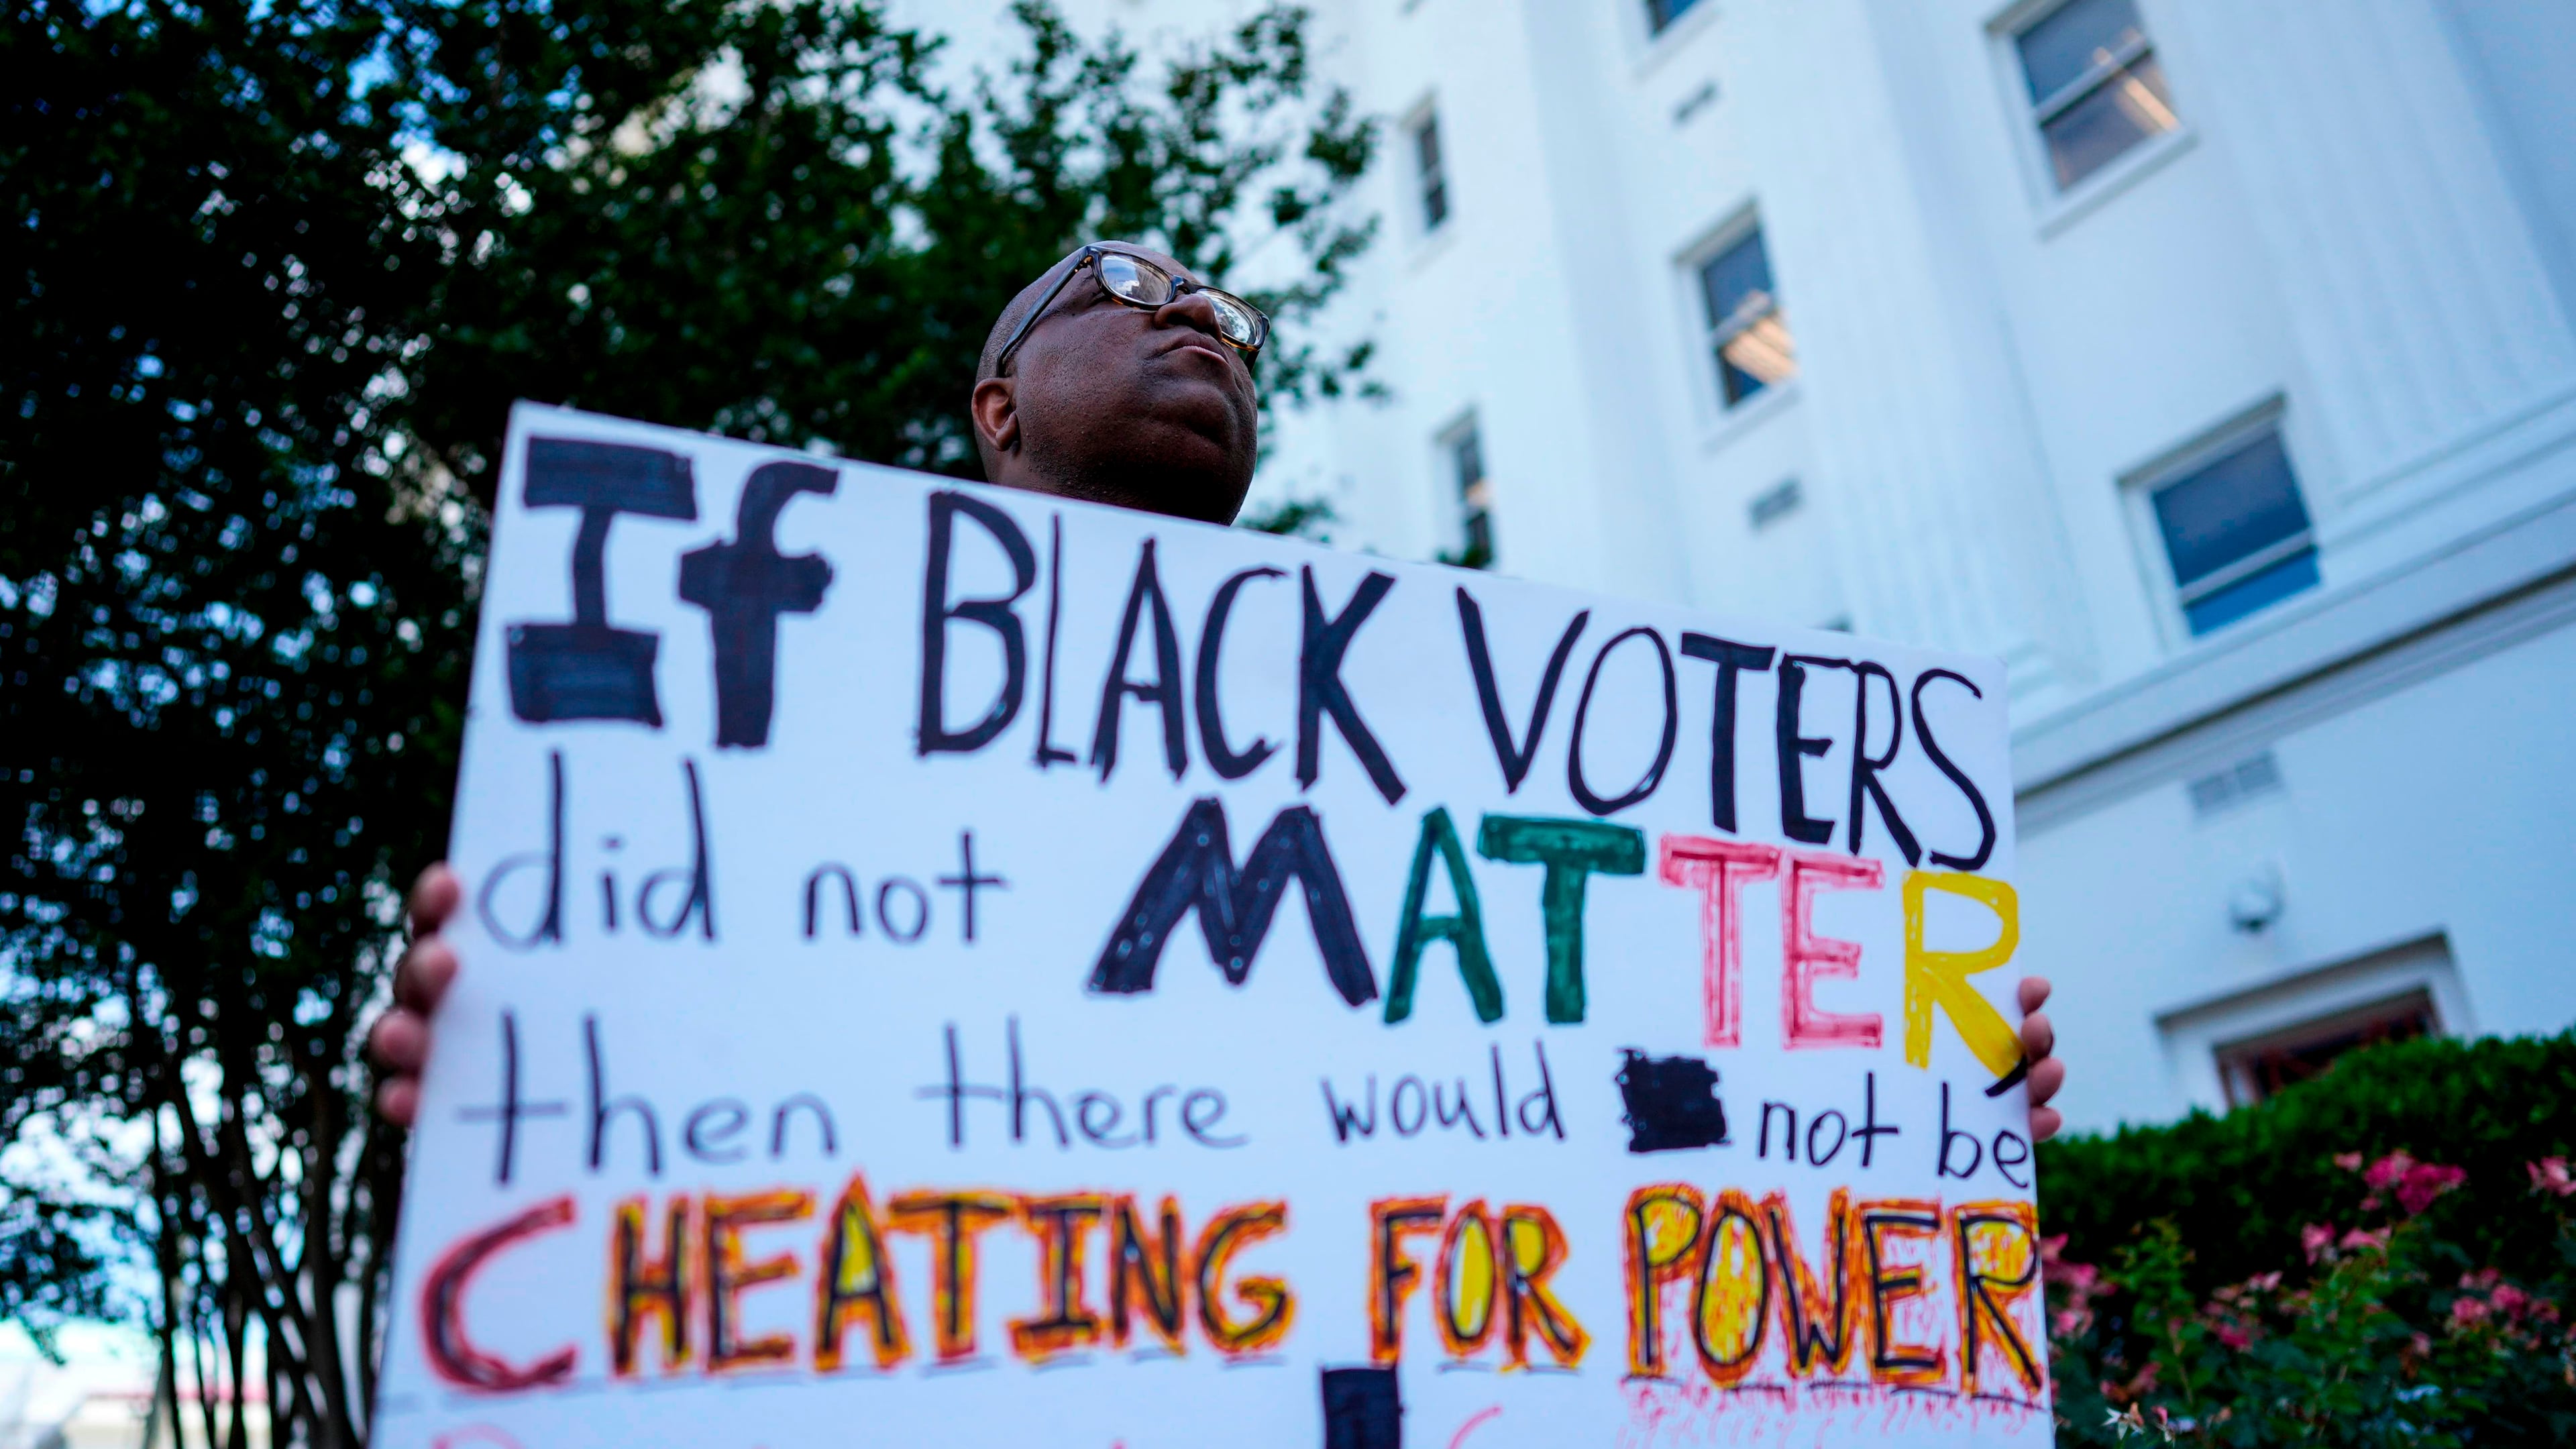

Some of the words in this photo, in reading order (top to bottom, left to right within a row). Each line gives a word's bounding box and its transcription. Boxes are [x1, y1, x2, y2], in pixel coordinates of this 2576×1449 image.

[508, 435, 839, 748] If
[917, 491, 1407, 805] BLACK
[1456, 586, 1996, 870] VOTERS
[478, 747, 718, 953] did
[805, 830, 1010, 945] not
[456, 1008, 838, 1187] then
[914, 1013, 1250, 1148] there
[1322, 1038, 1567, 1143] would
[1759, 1071, 1899, 1169] not
[1937, 1081, 2030, 1190] be
[419, 1169, 1298, 1394] CHEATING
[1368, 1191, 1592, 1373] FOR
[1621, 1183, 2044, 1399] POWER
